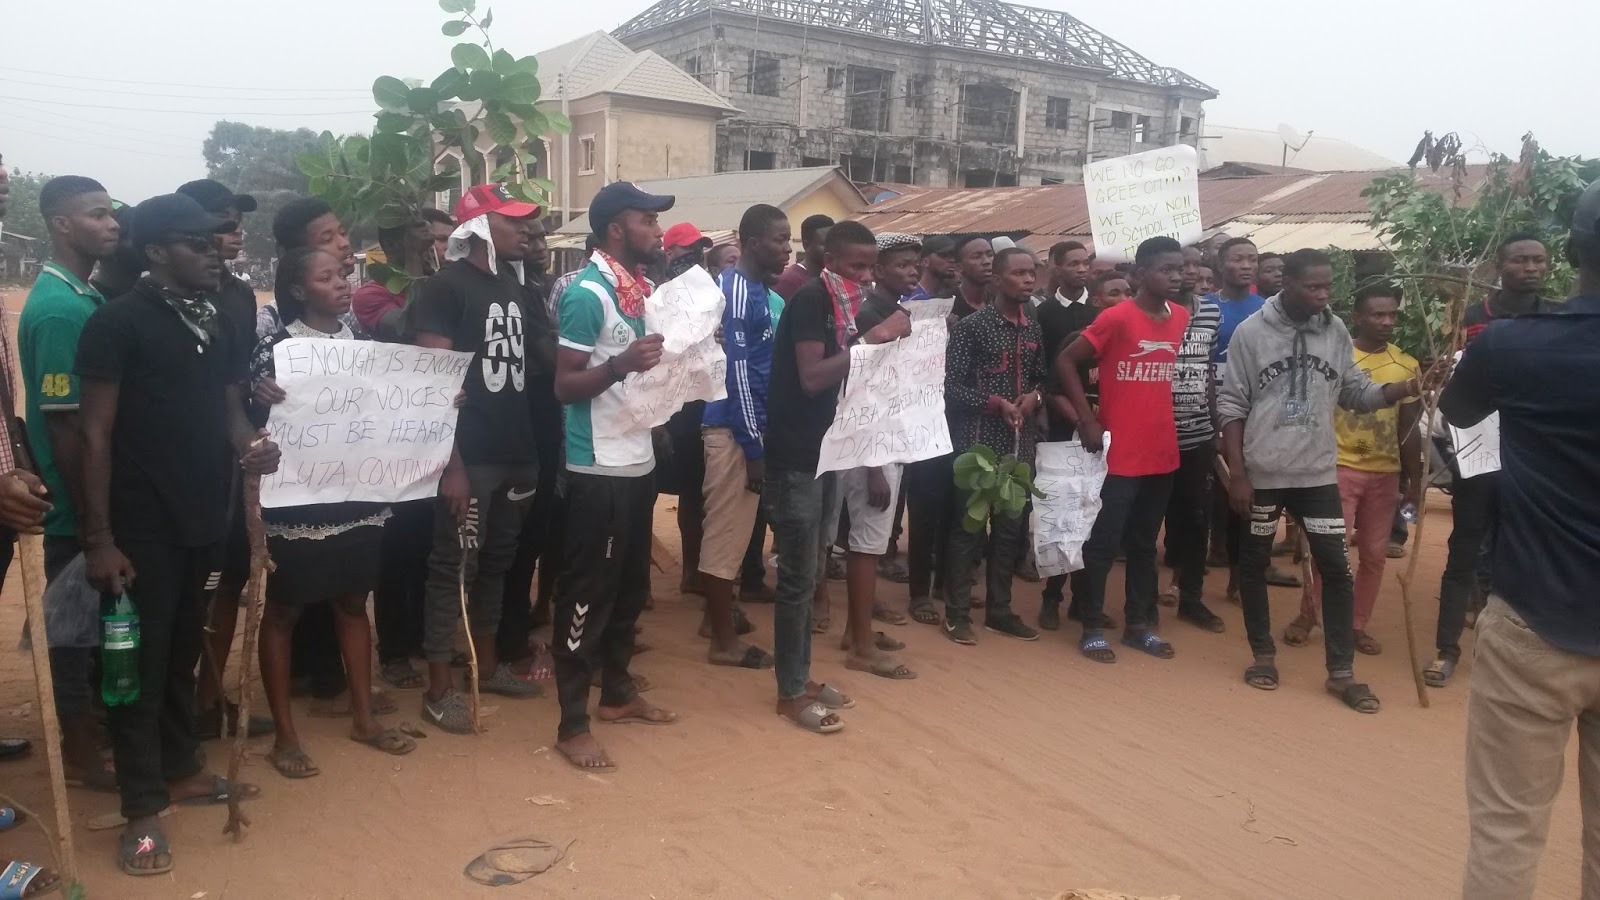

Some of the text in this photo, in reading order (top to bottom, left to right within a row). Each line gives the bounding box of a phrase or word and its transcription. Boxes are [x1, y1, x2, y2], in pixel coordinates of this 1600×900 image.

[1123, 160, 1144, 178] NO
[1155, 156, 1175, 172] GO
[1096, 184, 1137, 204] GREE
[1098, 211, 1124, 227] WE
[1130, 202, 1159, 221] SAY
[1098, 231, 1117, 246] TO
[1122, 220, 1168, 242] SCHOOL
[1173, 209, 1200, 229] FEES
[287, 343, 472, 377] ENOUGH IS ENOUGH
[41, 373, 70, 397] 48
[314, 385, 450, 414] OUR VOICES
[269, 418, 454, 449] MUST BE HEARD
[830, 403, 881, 435] HABA
